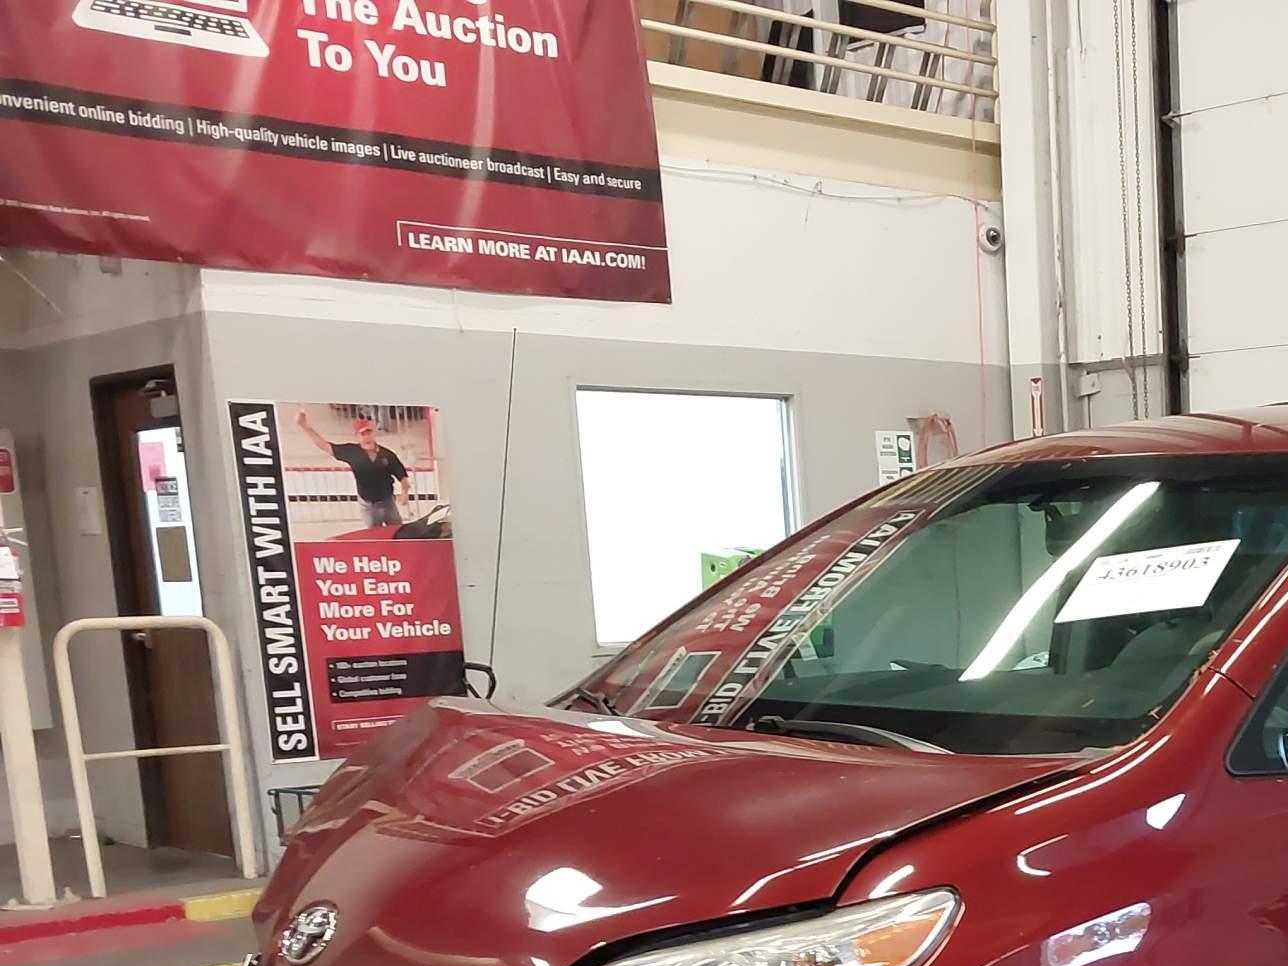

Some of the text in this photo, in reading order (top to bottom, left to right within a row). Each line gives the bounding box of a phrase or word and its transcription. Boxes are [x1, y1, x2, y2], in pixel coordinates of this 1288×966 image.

[392, 0, 558, 57] Auction
[297, 29, 447, 87] To You
[79, 104, 125, 123] online
[128, 110, 184, 135] bidding
[197, 119, 279, 147] High-quality
[281, 134, 328, 151] vehicle
[331, 137, 381, 158] images
[390, 144, 416, 162] Live
[419, 152, 484, 171] auctioneer
[487, 157, 545, 180] broadcast
[554, 167, 580, 187] Easy
[583, 172, 605, 186] and
[606, 176, 642, 190] secure
[408, 232, 647, 270] LEARN MORE AT IAAI.COM!
[238, 411, 308, 751] SELL SMART WITH IAA
[313, 556, 401, 576] We Help
[316, 578, 411, 596] You Earn
[319, 600, 414, 618] More For
[321, 620, 452, 641] Your Vehicle
